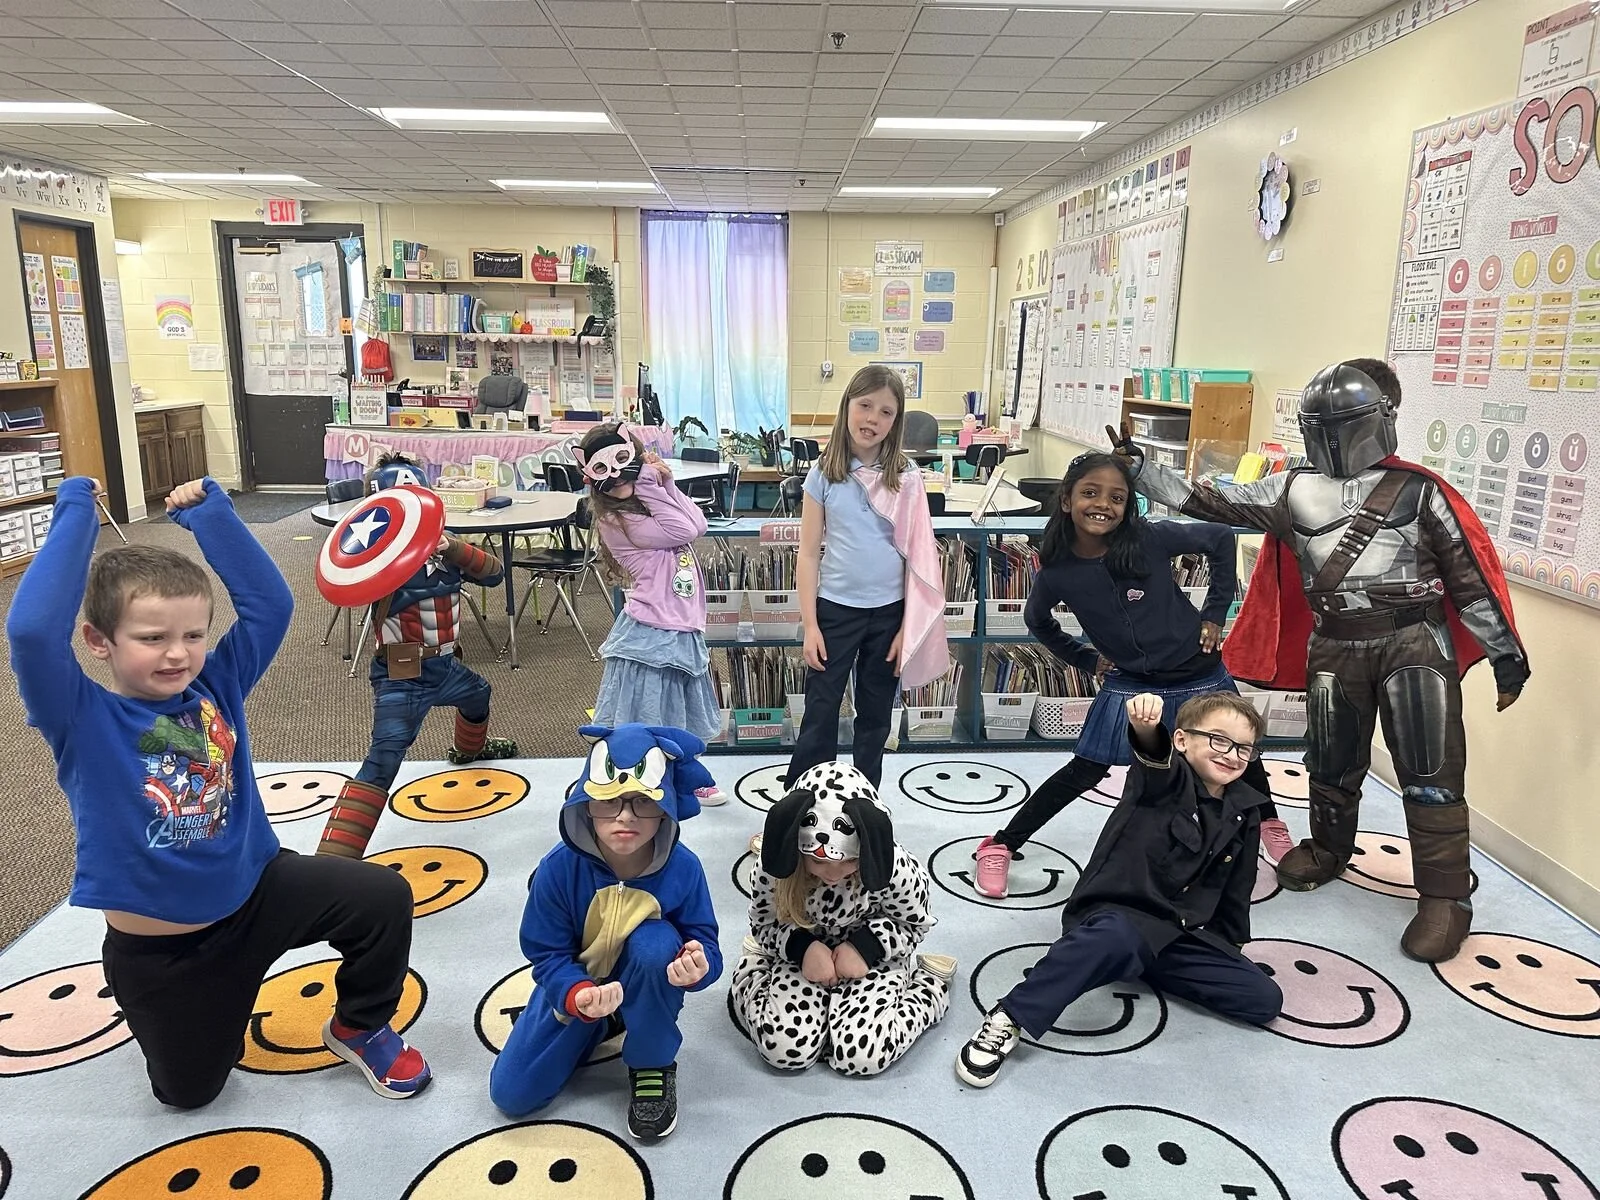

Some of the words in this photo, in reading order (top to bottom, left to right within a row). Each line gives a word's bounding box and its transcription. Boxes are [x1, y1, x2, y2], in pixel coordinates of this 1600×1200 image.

[1412, 0, 1421, 19] 68
[1396, 9, 1405, 27] 67
[1368, 24, 1376, 40] 65
[1526, 16, 1551, 36] POINT
[1546, 23, 1562, 34] under
[1509, 86, 1600, 196] SO
[1149, 164, 1154, 180] 8
[36, 190, 50, 202] Ww
[58, 194, 70, 206] Xx
[78, 198, 88, 212] Yy
[96, 202, 106, 213] Zz
[269, 201, 295, 222] EXIT
[1512, 224, 1528, 238] LONG
[1530, 220, 1552, 236] VOWELS
[876, 250, 922, 264] CLASSROOM
[1089, 231, 1121, 278] MATH
[1027, 254, 1034, 290] 5
[1038, 248, 1048, 288] 10
[1412, 262, 1426, 272] FLOSS
[1426, 260, 1437, 270] RULE
[1016, 258, 1024, 292] 2
[541, 304, 560, 312] HOME
[531, 319, 570, 328] CLASSROOM
[1564, 480, 1574, 488] tub
[440, 495, 457, 504] ABLE
[460, 496, 466, 505] 3
[1484, 497, 1495, 506] gym
[1560, 496, 1572, 505] gum
[1522, 505, 1534, 513] mom
[1556, 510, 1572, 521] shrug
[1516, 518, 1534, 528] swamp
[773, 526, 800, 540] FICTI
[1556, 526, 1566, 534] cut
[1513, 531, 1532, 542] octopus
[1553, 539, 1564, 551] bug
[181, 806, 201, 815] MARVEL
[146, 811, 214, 848] AVENGERS
